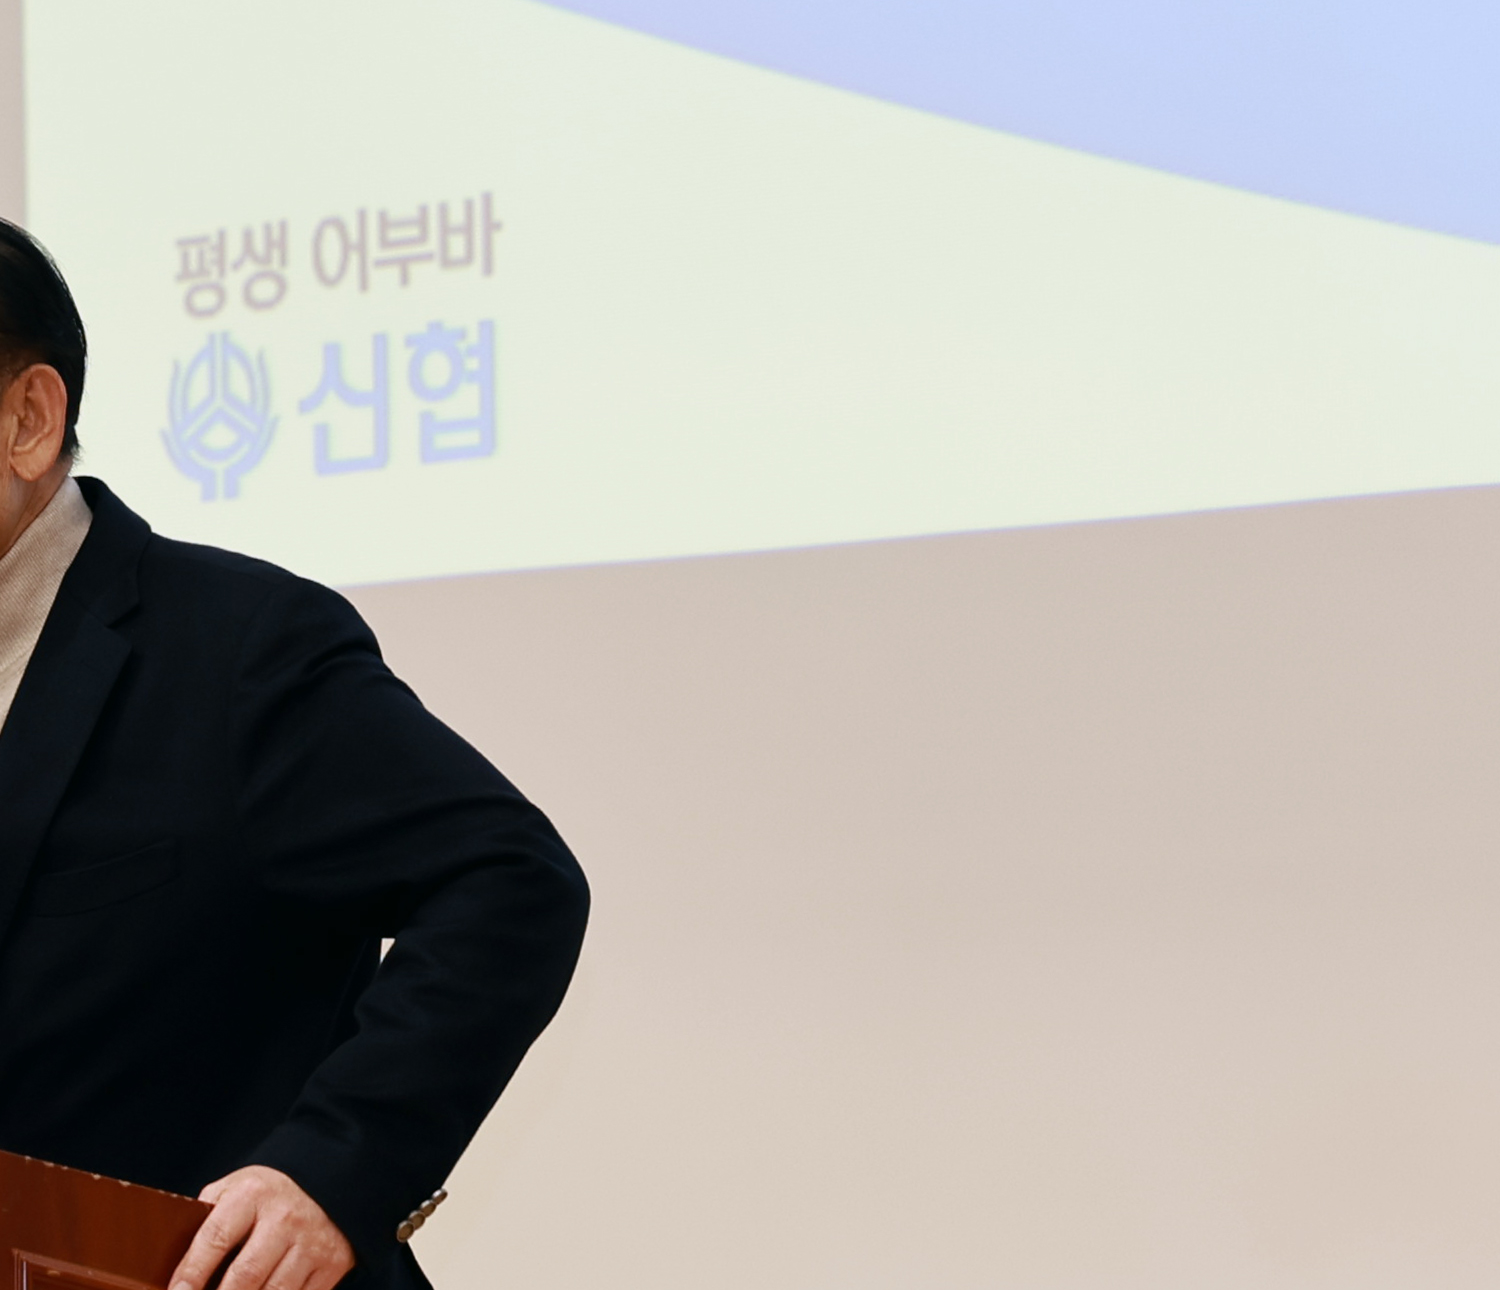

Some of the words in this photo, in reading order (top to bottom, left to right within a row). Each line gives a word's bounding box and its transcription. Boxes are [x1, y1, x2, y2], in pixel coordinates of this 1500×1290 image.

[174, 219, 288, 319] 평생
[311, 191, 503, 293] 어부바
[298, 318, 496, 477] 신협
